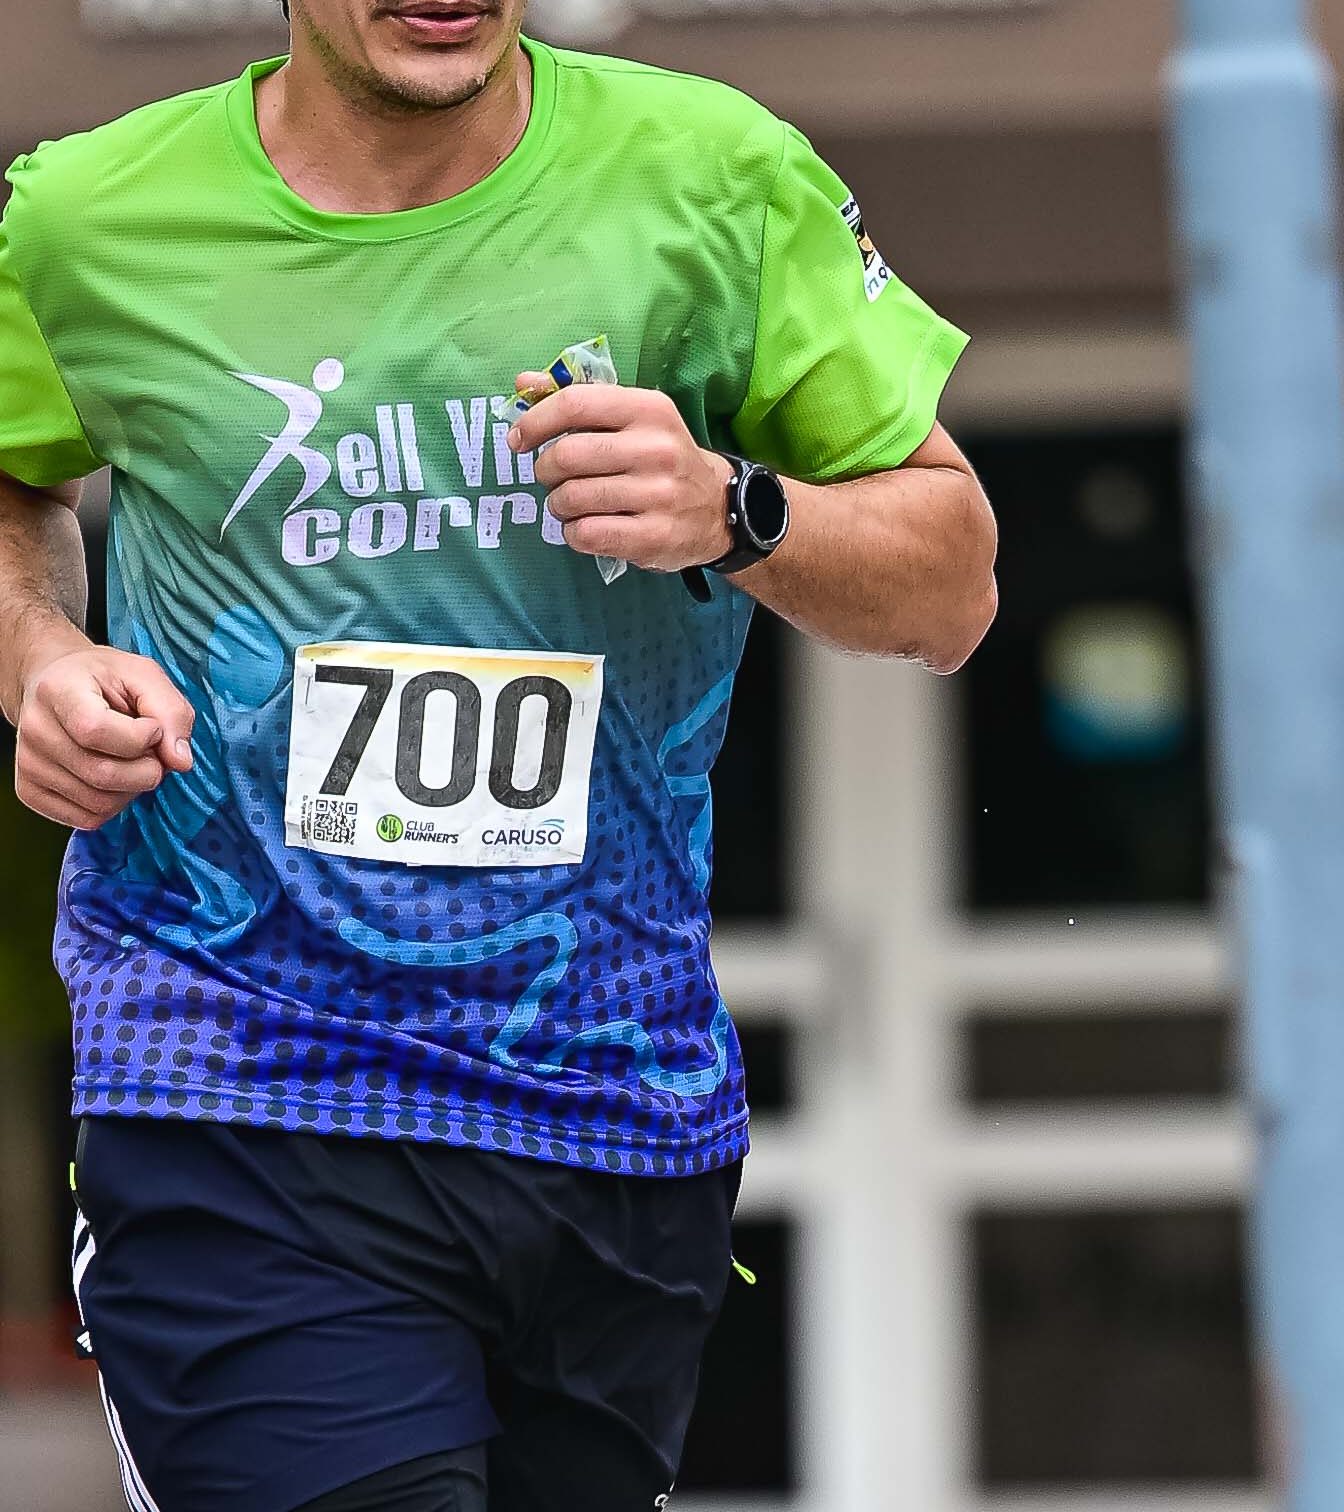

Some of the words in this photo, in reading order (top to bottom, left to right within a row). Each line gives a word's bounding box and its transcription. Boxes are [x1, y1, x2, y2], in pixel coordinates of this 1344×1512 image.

[314, 664, 572, 809] 700
[406, 820, 435, 831] CLUB
[481, 829, 562, 845] CARUSO
